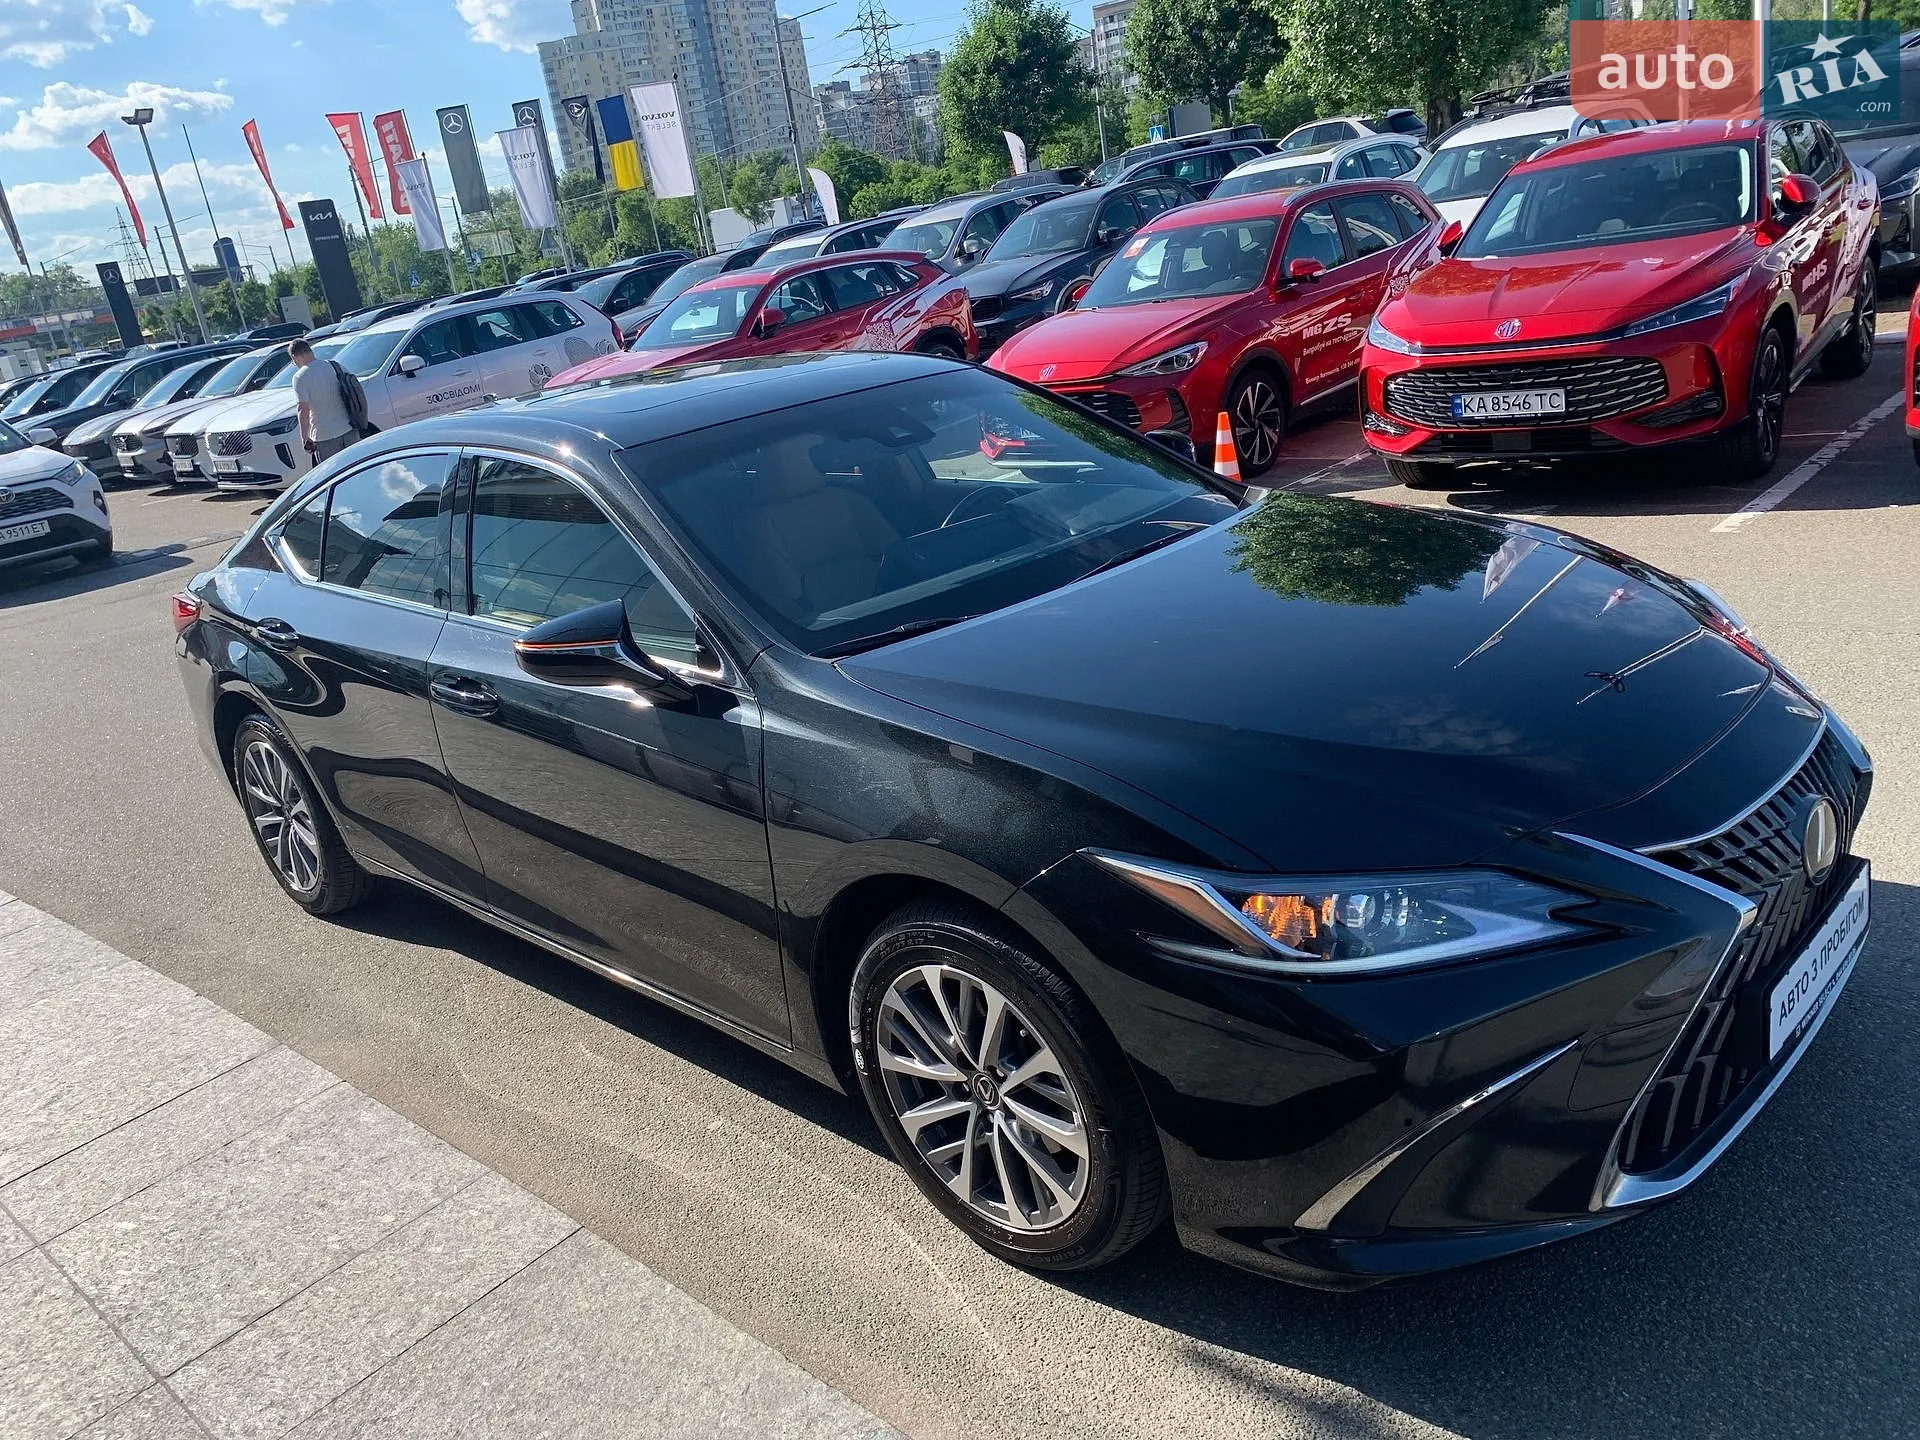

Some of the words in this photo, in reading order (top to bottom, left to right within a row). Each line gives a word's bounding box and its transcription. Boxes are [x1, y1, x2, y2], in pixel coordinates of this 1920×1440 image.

[309, 211, 333, 221] KIA
[1302, 323, 1323, 340] MG
[1322, 312, 1352, 334] ZS
[1463, 396, 1487, 413] KA
[1491, 394, 1531, 412] 8546
[1534, 392, 1561, 410] TC
[6, 525, 30, 538] 9511
[31, 521, 46, 533] ET
[1779, 970, 1809, 1027] АВТО
[1820, 891, 1864, 970] ПРОБІГОМ
